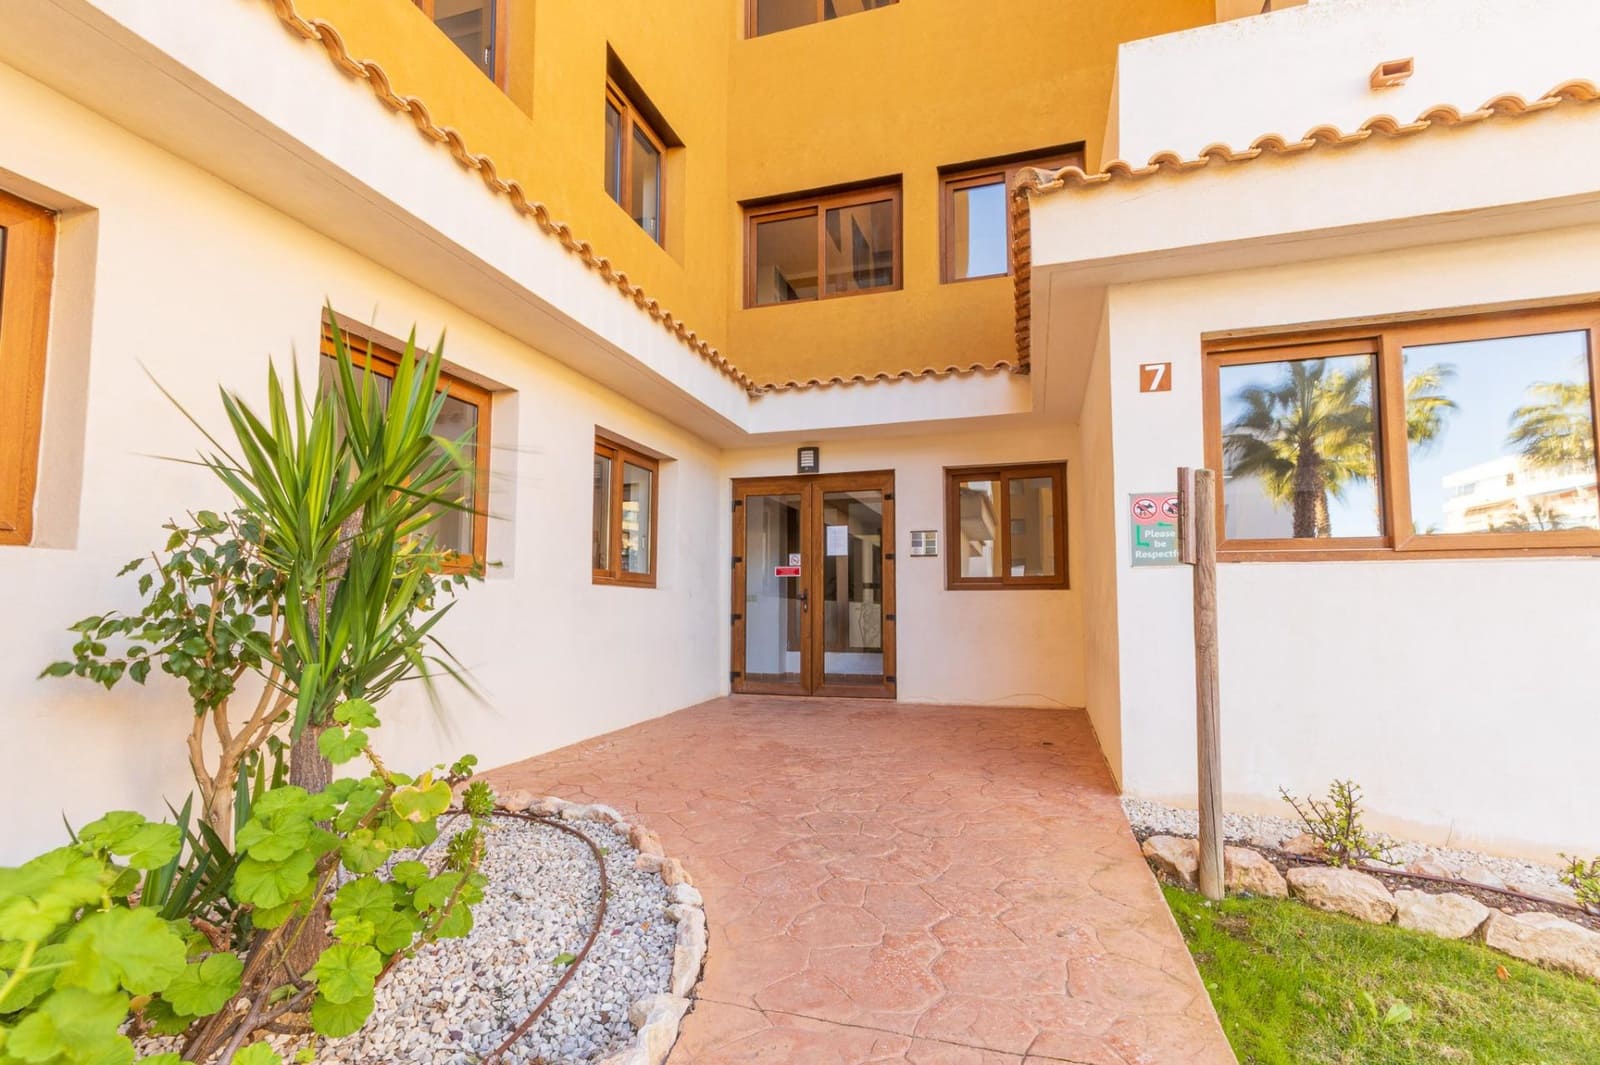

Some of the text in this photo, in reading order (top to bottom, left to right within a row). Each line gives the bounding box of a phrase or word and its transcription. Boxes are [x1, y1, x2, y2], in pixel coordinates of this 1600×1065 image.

[1145, 364, 1165, 391] 7
[1144, 529, 1176, 538] Please
[1154, 540, 1167, 548] be
[1135, 549, 1179, 559] Respectf
